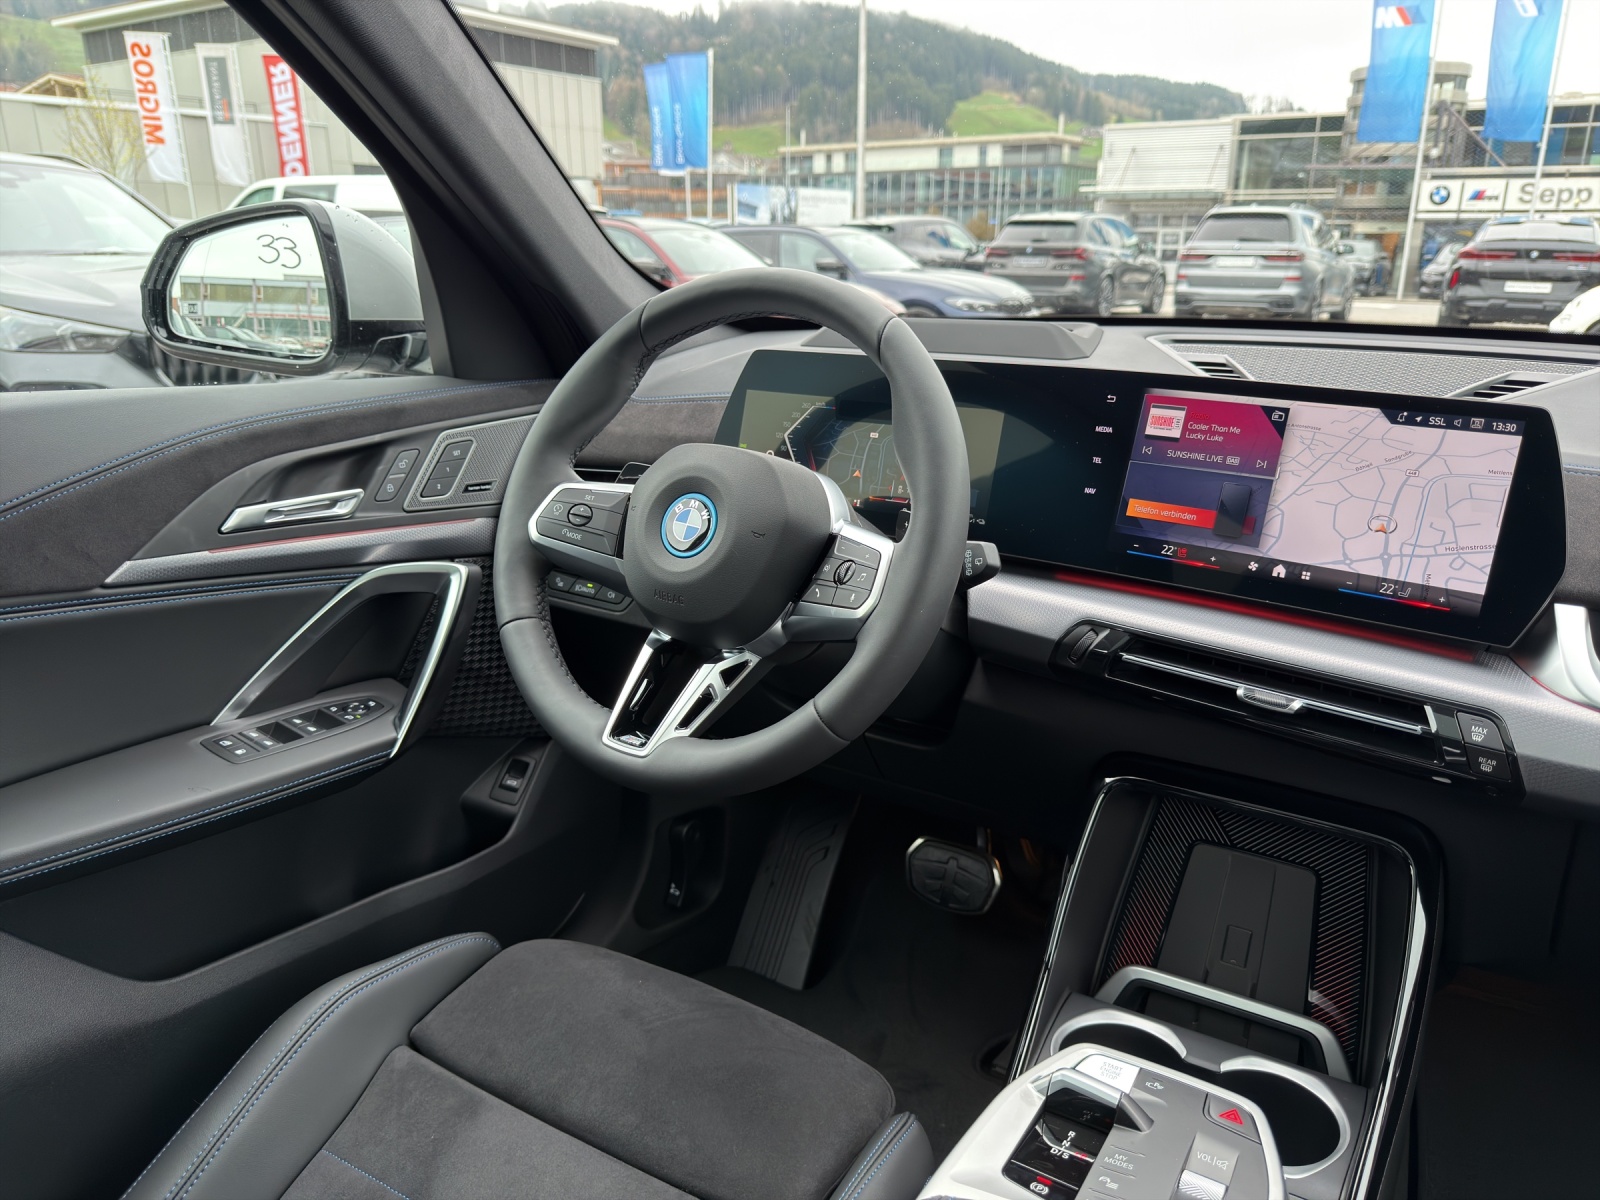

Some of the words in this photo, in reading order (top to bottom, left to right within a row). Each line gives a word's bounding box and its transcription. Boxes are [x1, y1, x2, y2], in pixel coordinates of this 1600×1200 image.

[1518, 182, 1593, 208] Sepp
[256, 234, 302, 269] 33
[1428, 416, 1446, 426] SSL
[1491, 421, 1517, 433] 13:30
[1095, 425, 1114, 435] MEDIA
[1187, 421, 1209, 432] Cooler
[1211, 423, 1228, 434] Than
[1229, 426, 1241, 435] Me
[1185, 431, 1205, 442] Lucky
[1206, 433, 1224, 443] Luke
[1092, 456, 1103, 465] TEL
[1167, 449, 1206, 462] SUNSHINE
[1206, 453, 1224, 463] LIVE
[1084, 487, 1097, 495] NAV
[674, 498, 711, 520] BMW
[1133, 504, 1159, 516] Telefon
[1160, 509, 1197, 522] verbinden
[566, 532, 583, 541] MODE
[653, 589, 685, 606] AIRBAG
[1471, 726, 1488, 735] MAX
[1478, 757, 1496, 766] REAR
[1099, 1066, 1122, 1078] ENGINE
[1102, 1062, 1123, 1072] START
[1100, 1071, 1118, 1081] STOP
[1113, 1153, 1129, 1161] MY
[1197, 1151, 1212, 1163] VOL
[1104, 1157, 1134, 1170] MODES
